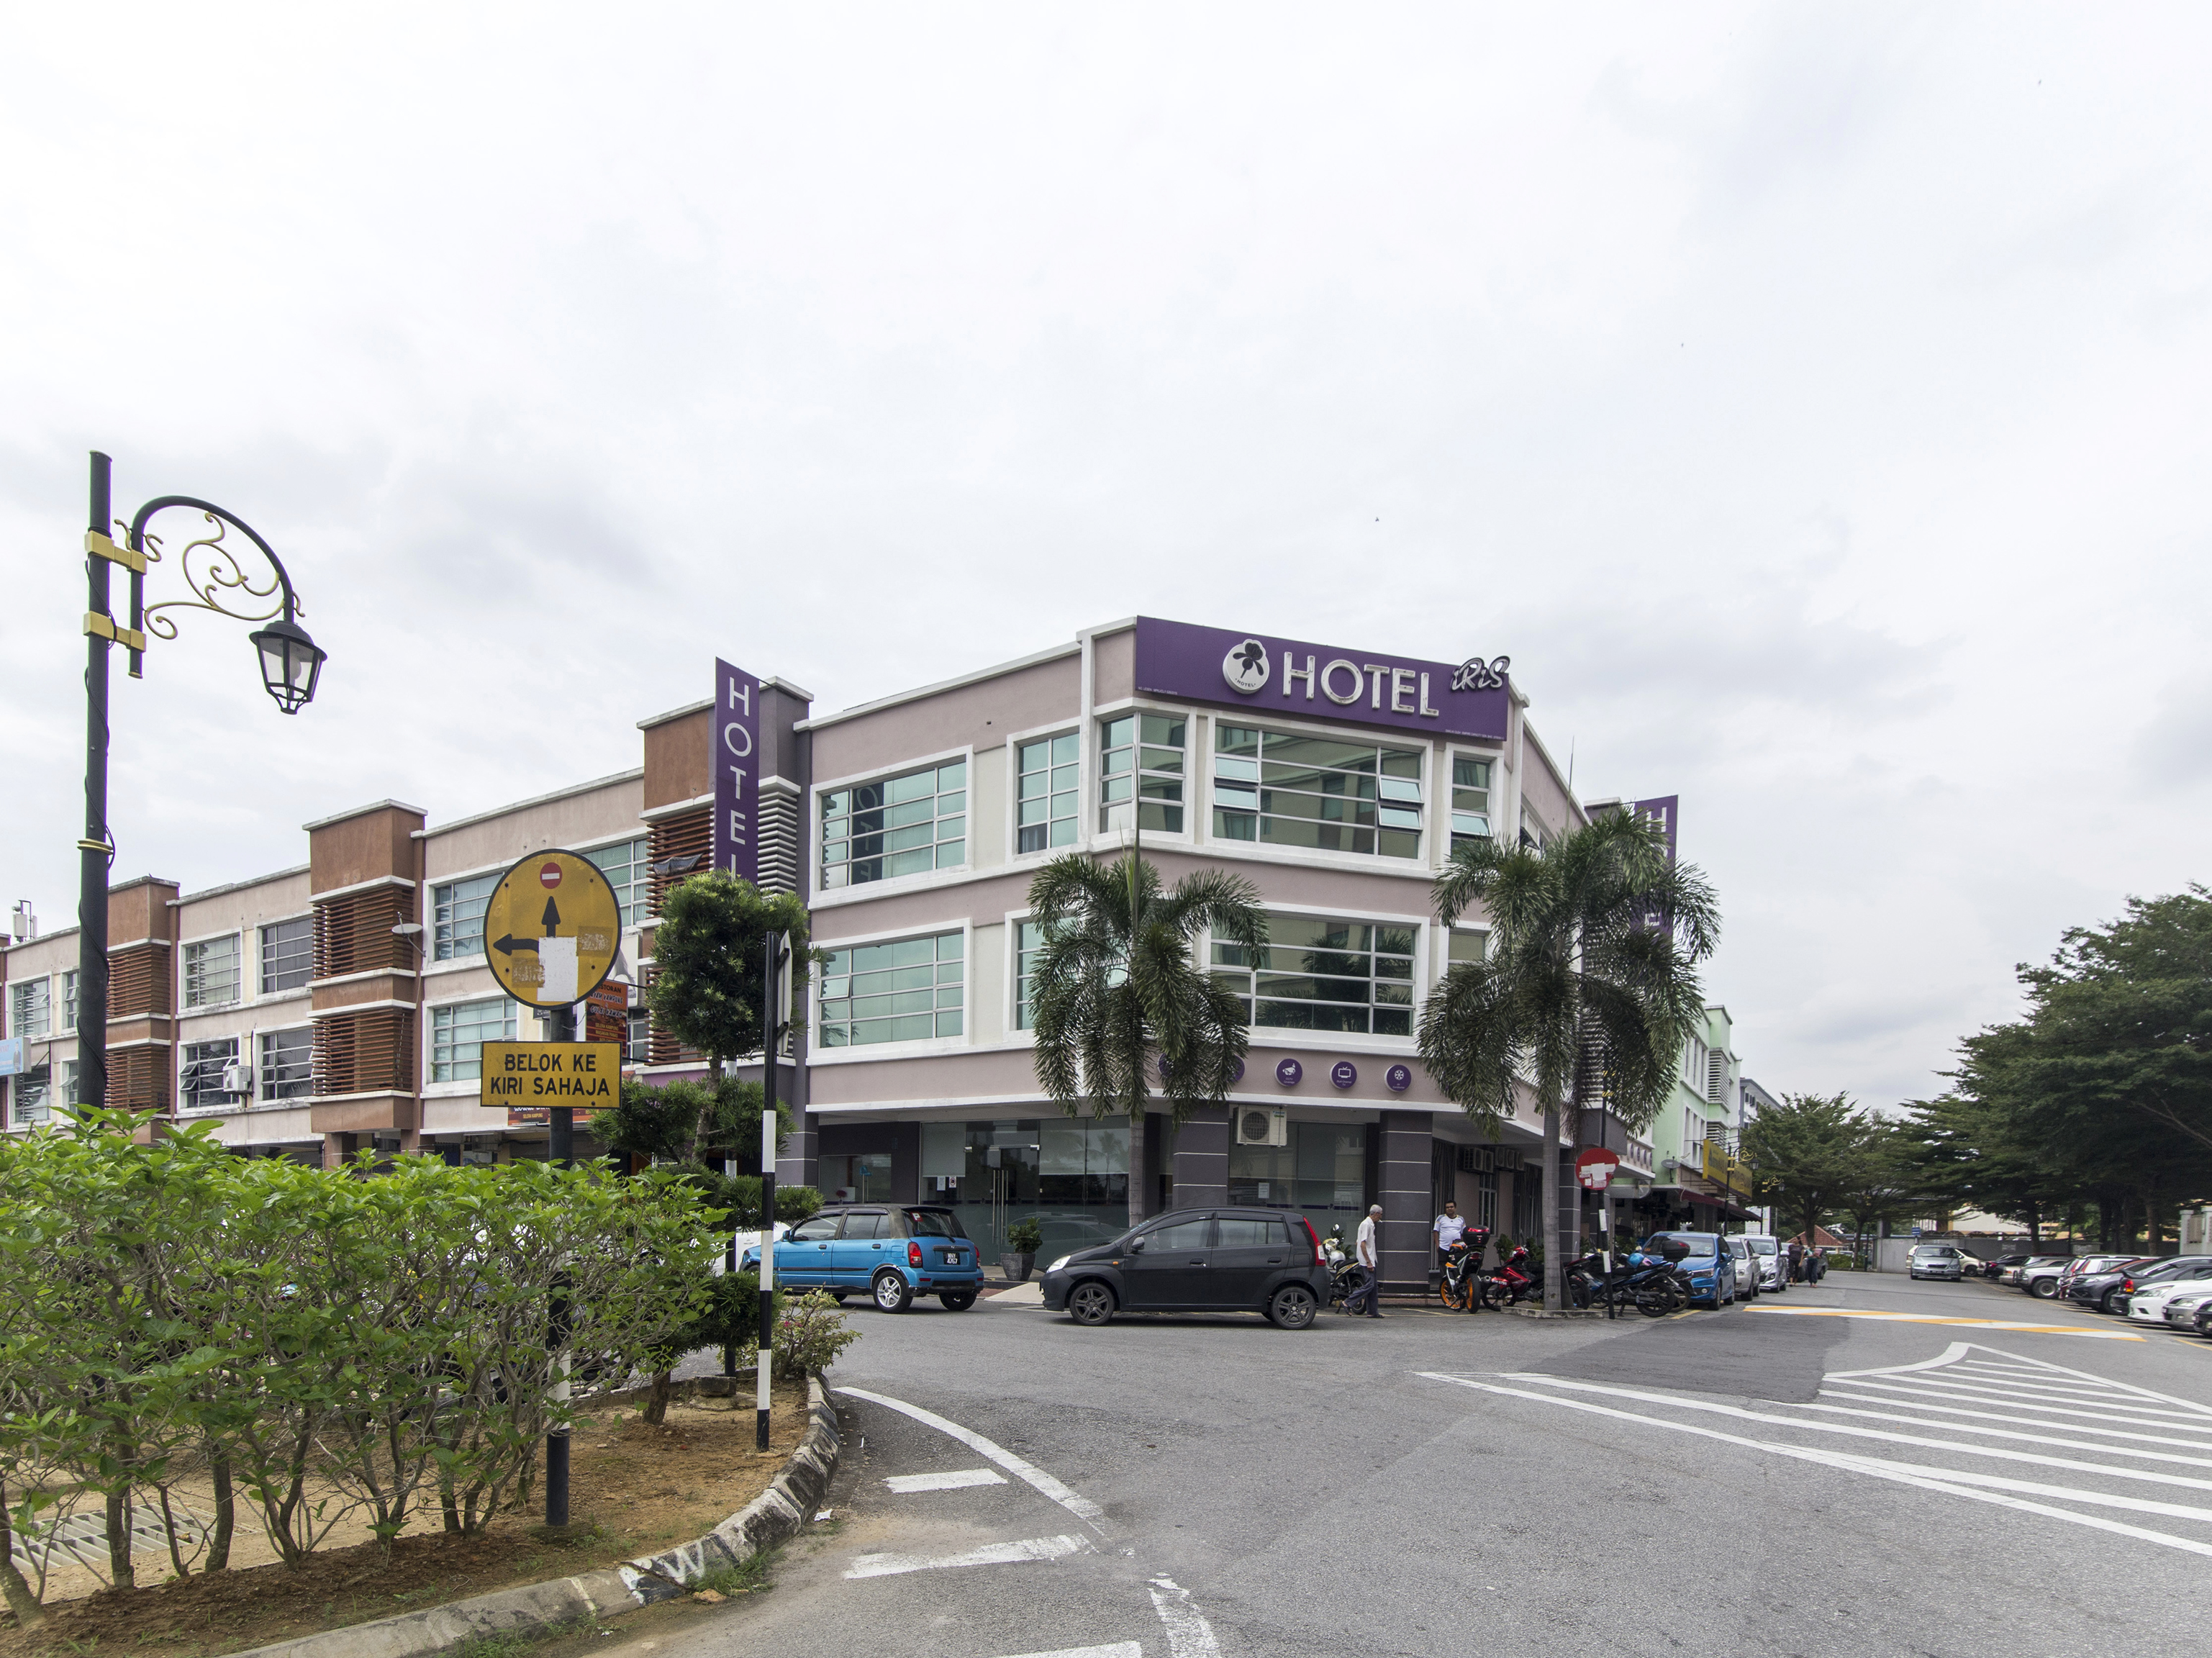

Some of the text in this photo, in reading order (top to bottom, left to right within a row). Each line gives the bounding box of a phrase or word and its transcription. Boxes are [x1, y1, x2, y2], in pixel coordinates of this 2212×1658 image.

[1237, 679, 1255, 687] HOTEL
[1283, 651, 1439, 717] HOTEL
[598, 984, 622, 993] STORAN
[504, 1054, 597, 1072] BELOK KE
[491, 1077, 610, 1096] KIRI SAHAJA
